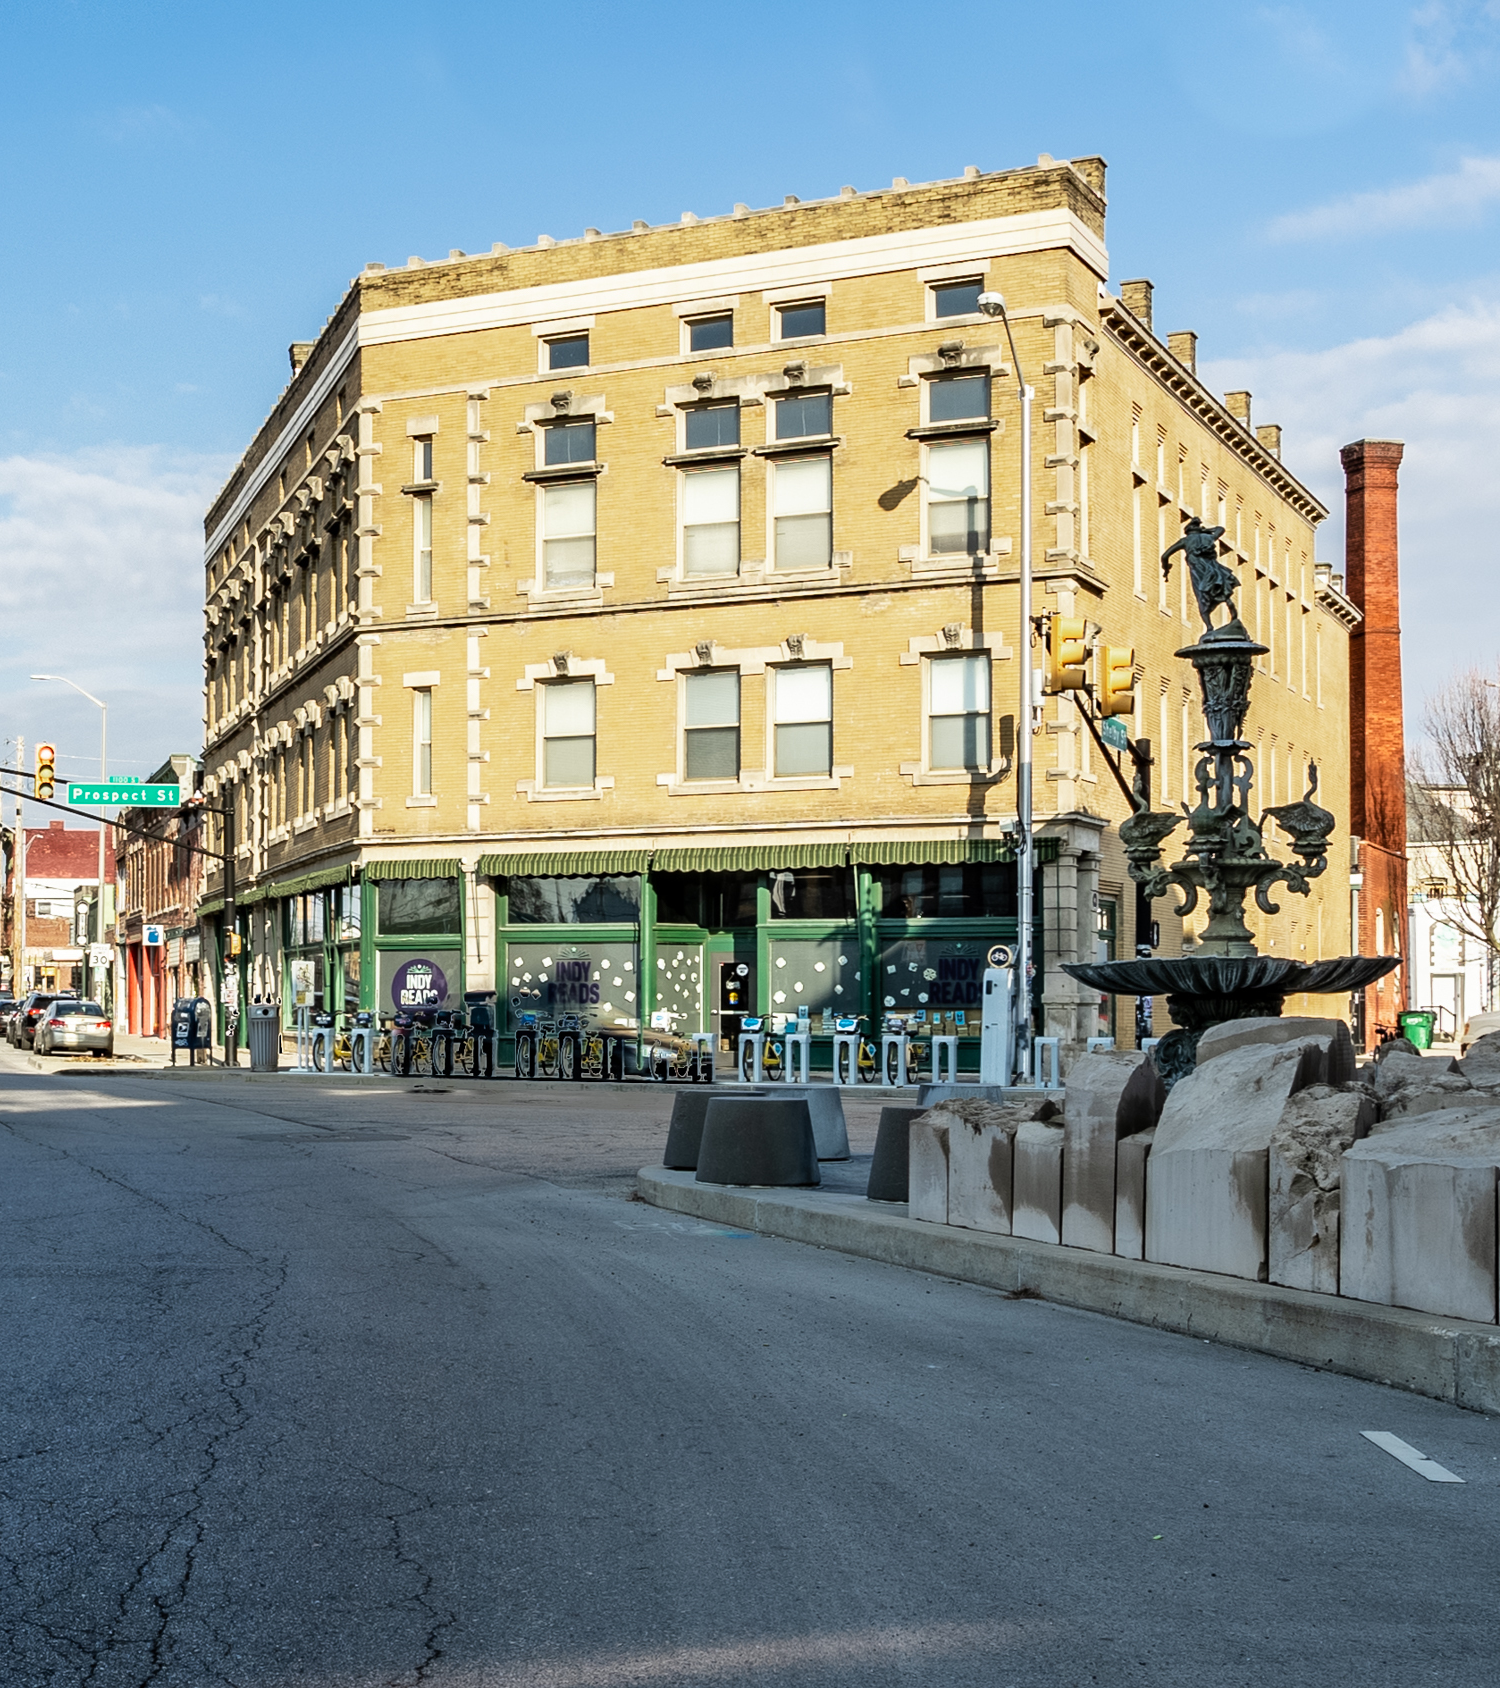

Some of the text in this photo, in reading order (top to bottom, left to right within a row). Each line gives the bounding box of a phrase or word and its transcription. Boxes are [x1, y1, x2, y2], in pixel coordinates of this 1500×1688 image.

[73, 788, 174, 802] Prospect St
[93, 955, 108, 964] 30
[939, 958, 980, 981] INDY
[406, 974, 432, 989] INDY
[556, 961, 591, 982] INDY
[547, 983, 600, 1004] READS
[929, 982, 983, 1004] READ
